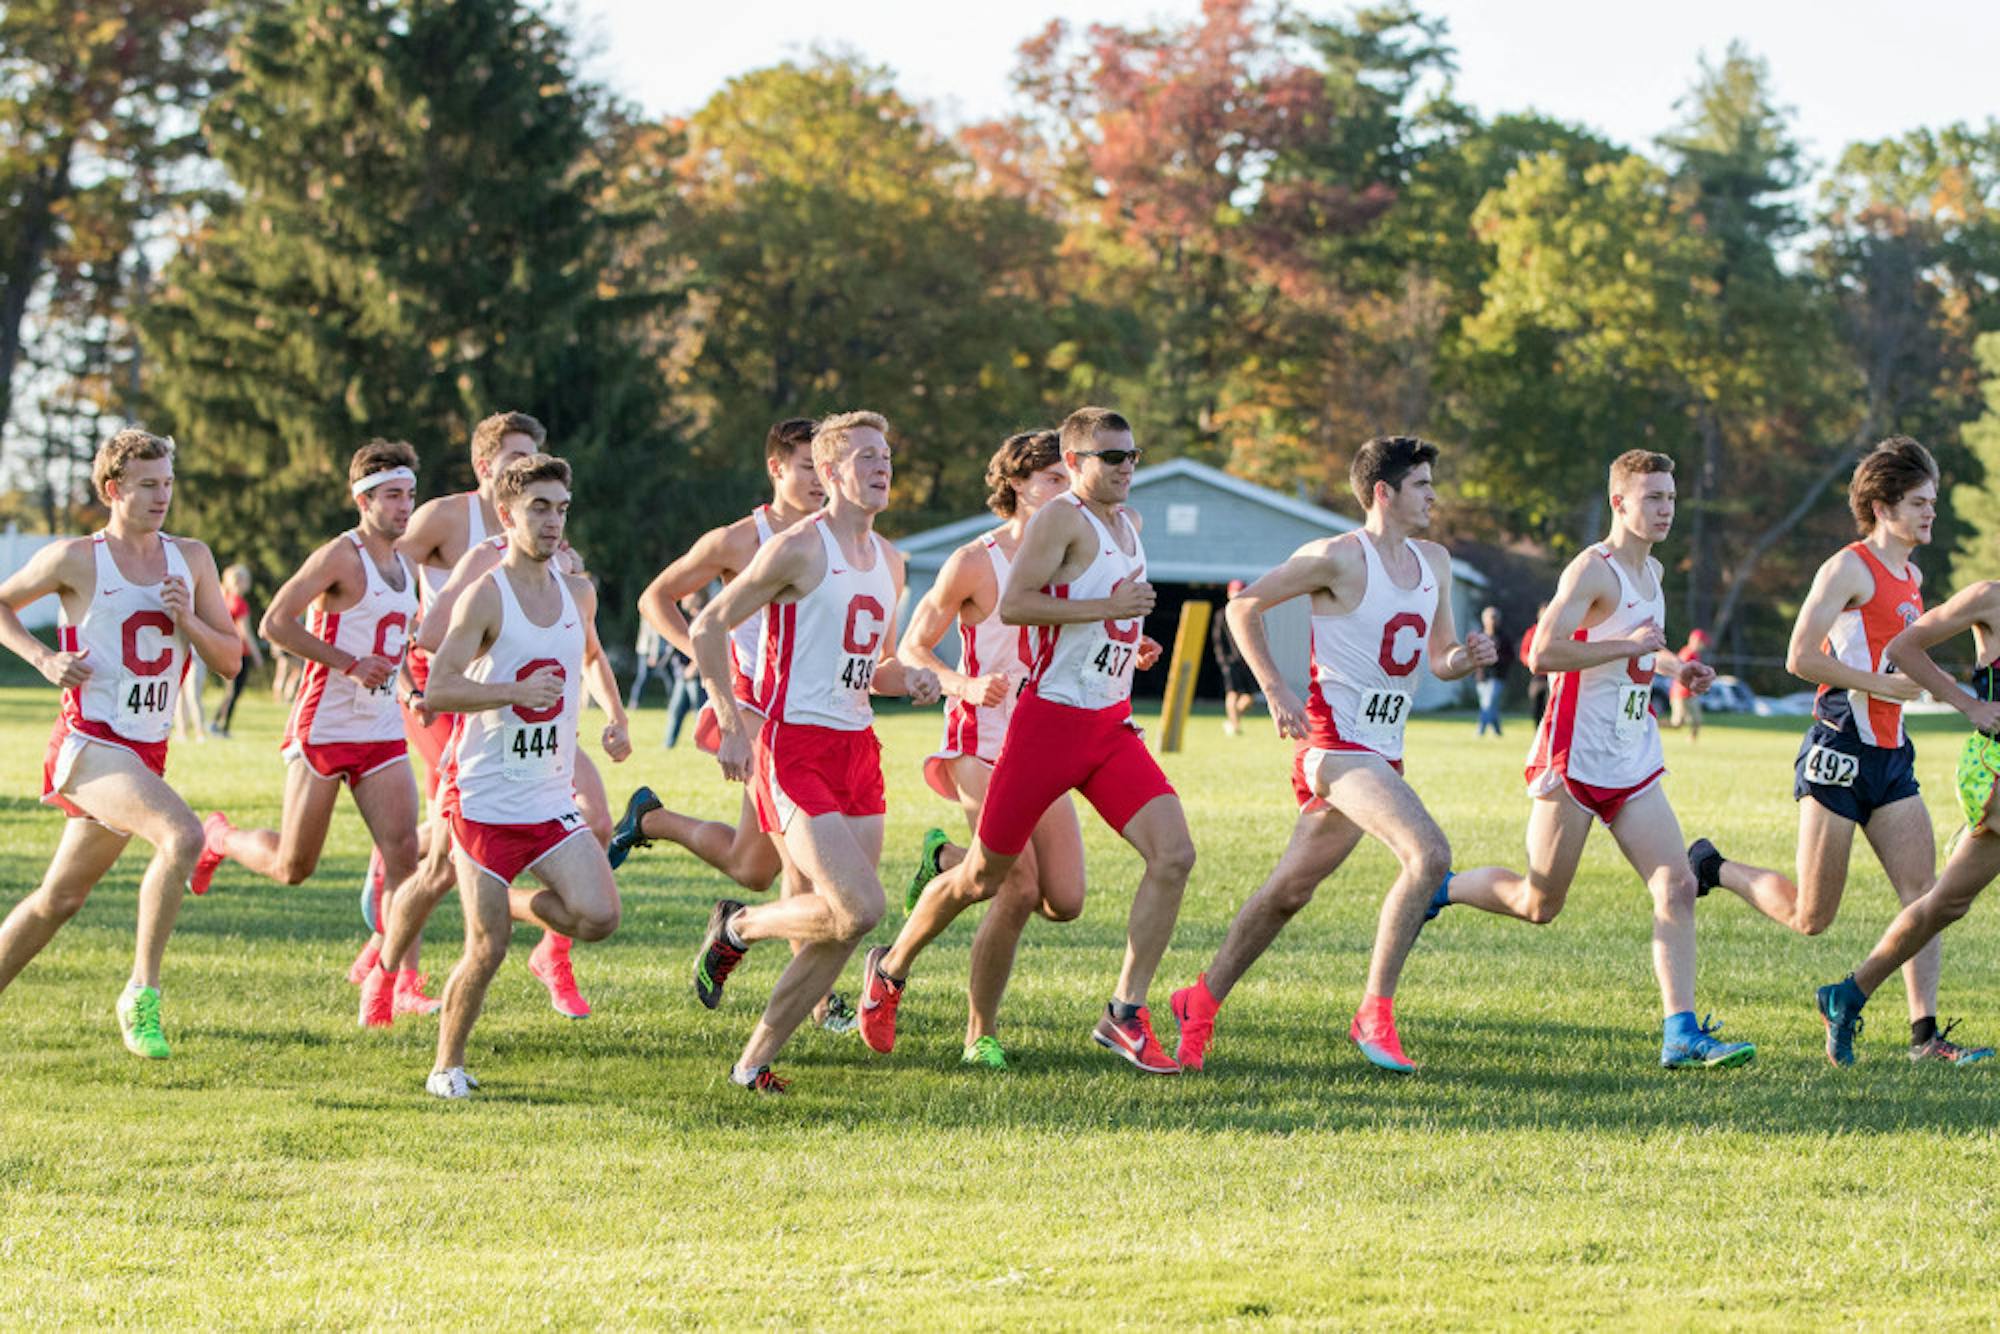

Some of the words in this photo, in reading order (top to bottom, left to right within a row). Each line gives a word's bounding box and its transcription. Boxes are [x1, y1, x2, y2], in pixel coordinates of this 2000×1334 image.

[372, 611, 406, 665] C
[844, 594, 884, 655] C
[122, 610, 174, 676] C
[1094, 643, 1132, 677] 437
[1378, 612, 1426, 676] C
[127, 681, 168, 714] 440
[1366, 694, 1404, 724] 443
[1624, 690, 1648, 720] 43
[512, 725, 558, 759] 444
[1810, 750, 1854, 782] 492
